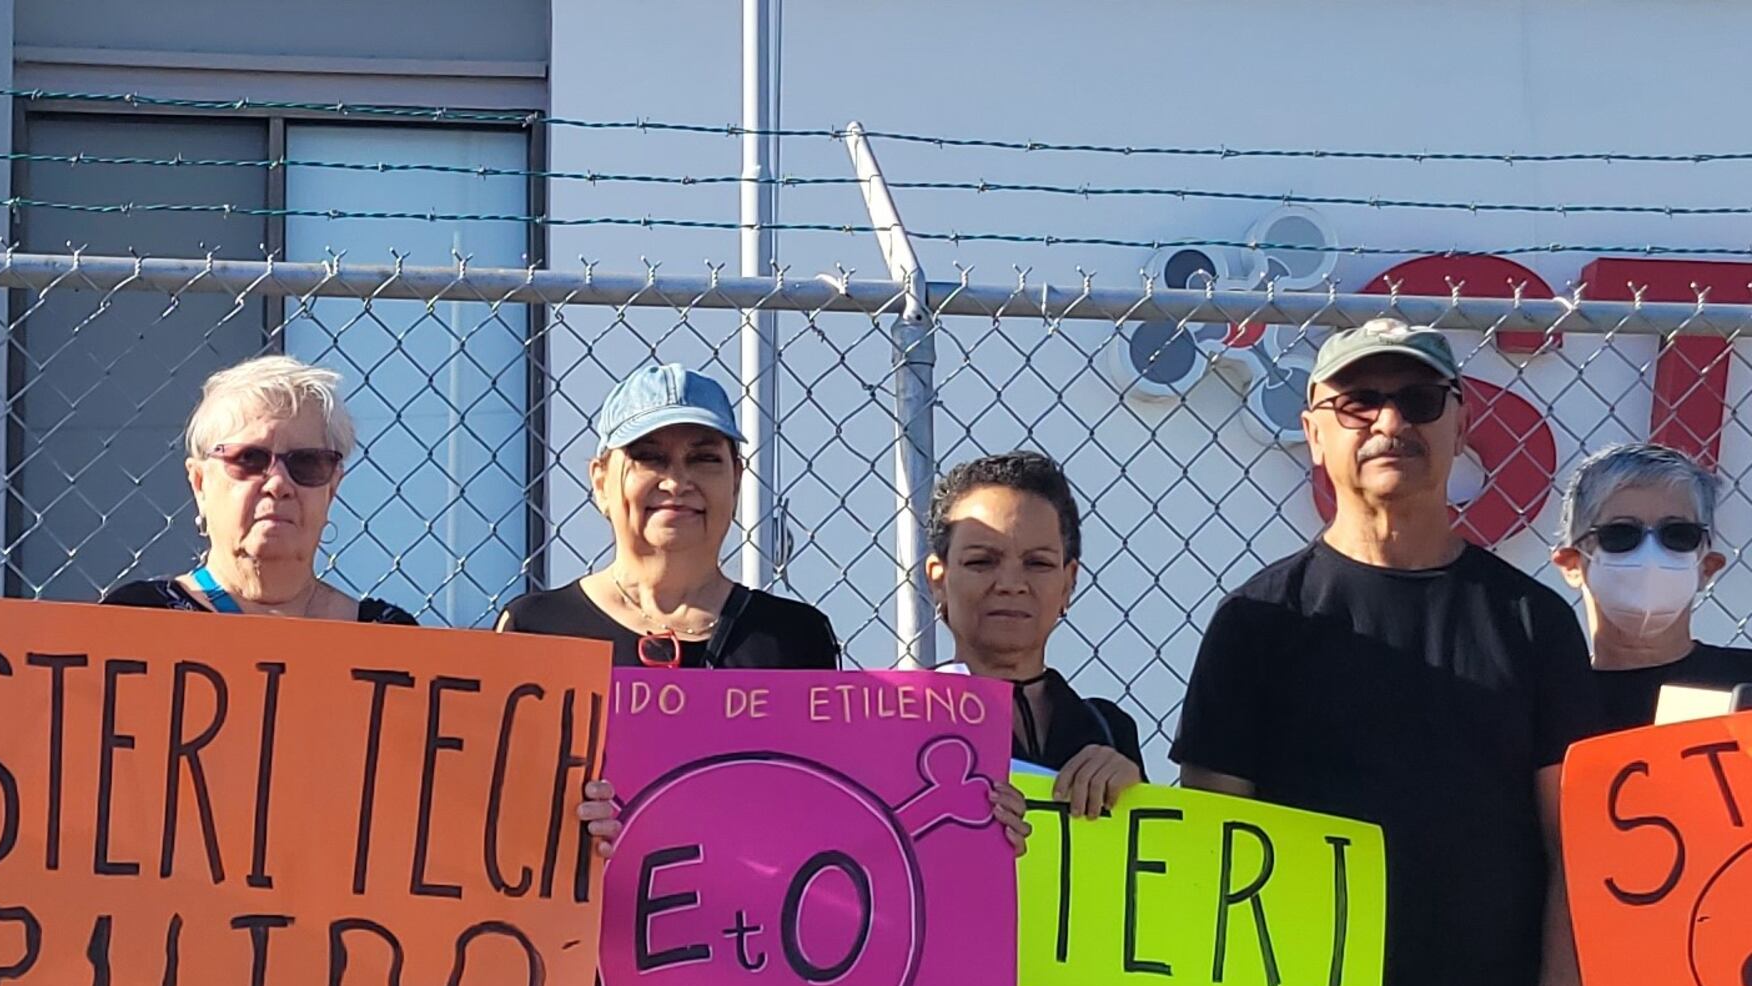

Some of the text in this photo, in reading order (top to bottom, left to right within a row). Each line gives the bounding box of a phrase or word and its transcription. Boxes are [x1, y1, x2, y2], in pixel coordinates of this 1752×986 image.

[614, 681, 986, 724] IDO DE ETILENO
[350, 667, 602, 904] TECH
[635, 843, 875, 985] EtO
